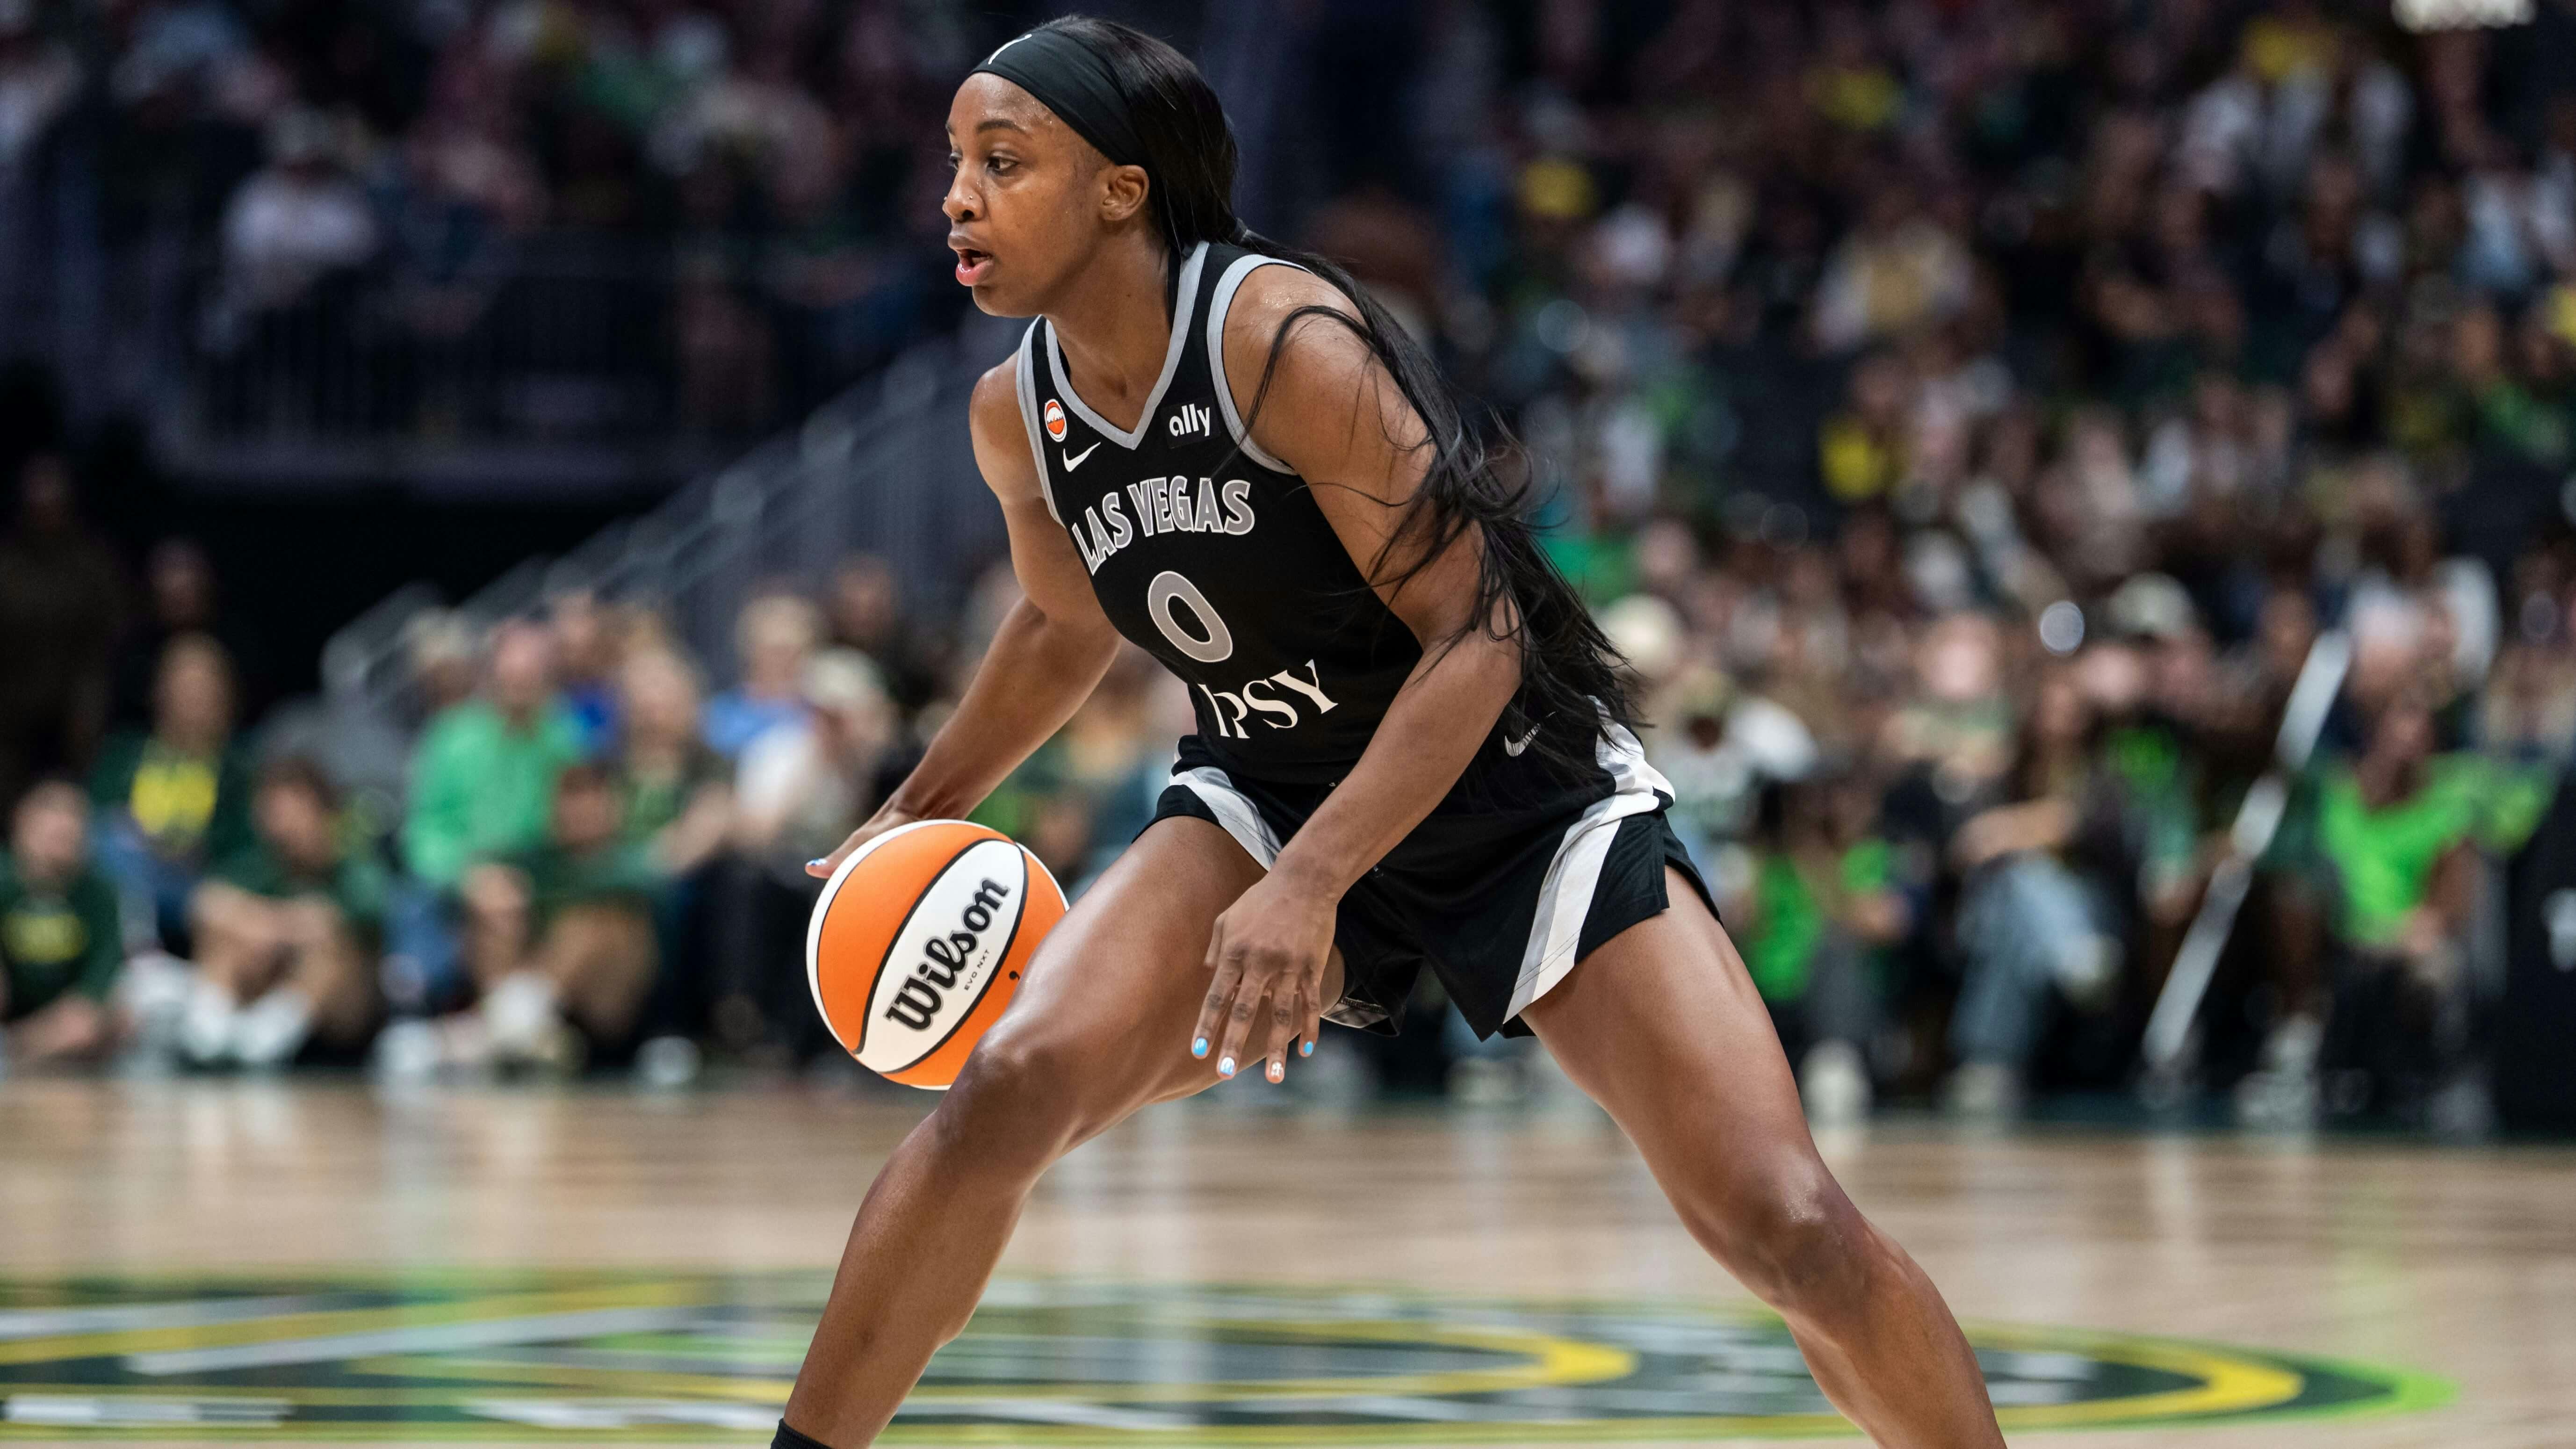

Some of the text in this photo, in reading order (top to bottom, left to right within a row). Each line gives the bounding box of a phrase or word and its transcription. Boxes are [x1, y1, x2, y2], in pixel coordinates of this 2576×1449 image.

[1169, 403, 1210, 437] ally
[1072, 475, 1255, 576] LAS VEGAS
[1147, 570, 1233, 663] 0
[883, 876, 1011, 1032] Wilson
[964, 949, 990, 991] EVO NXT
